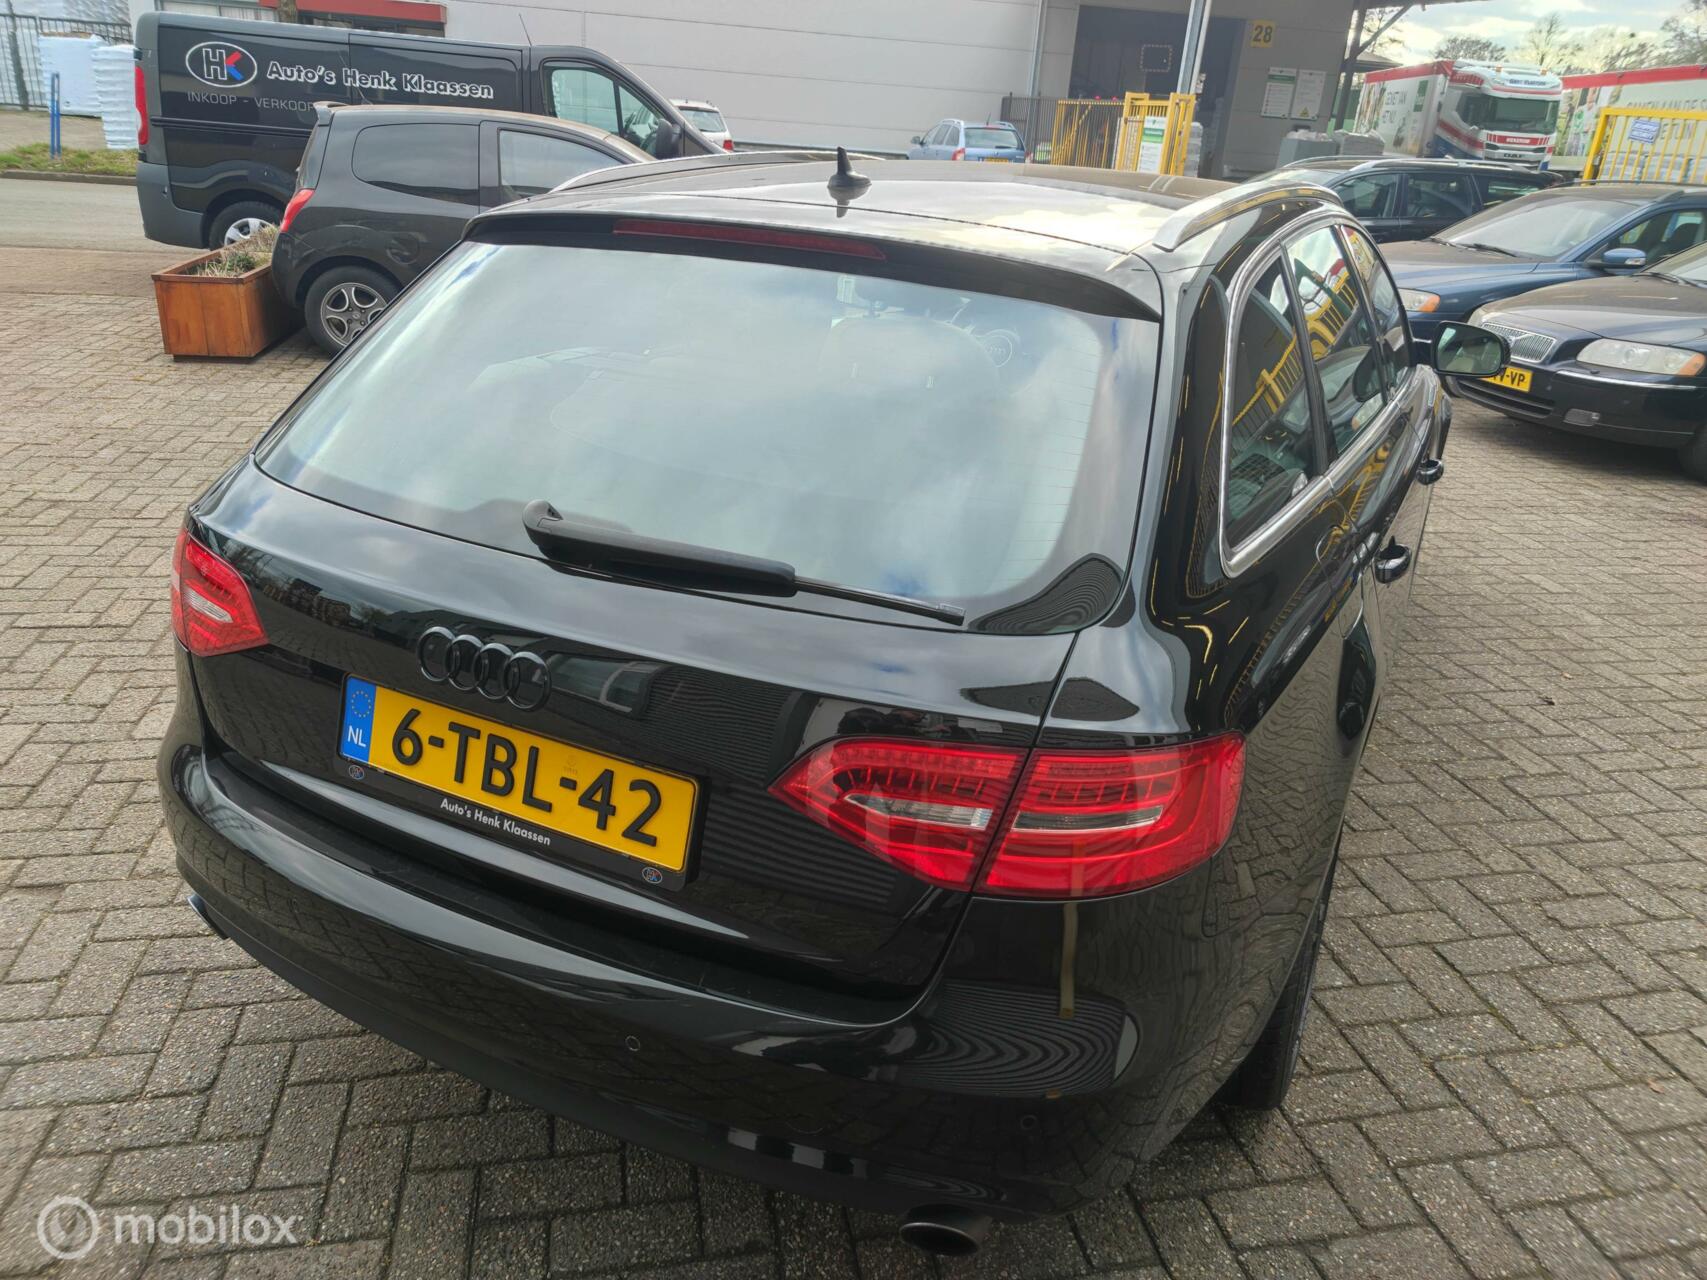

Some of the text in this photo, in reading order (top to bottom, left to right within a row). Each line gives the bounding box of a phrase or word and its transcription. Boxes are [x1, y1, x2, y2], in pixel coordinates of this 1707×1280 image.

[1252, 25, 1273, 43] 28
[267, 60, 494, 99] Auto's Henk Klaassen
[187, 91, 237, 105] INKOOP
[347, 725, 367, 749] NL
[391, 708, 663, 848] 6-TBL-42
[440, 798, 552, 847] Auto's Henk Klaassen
